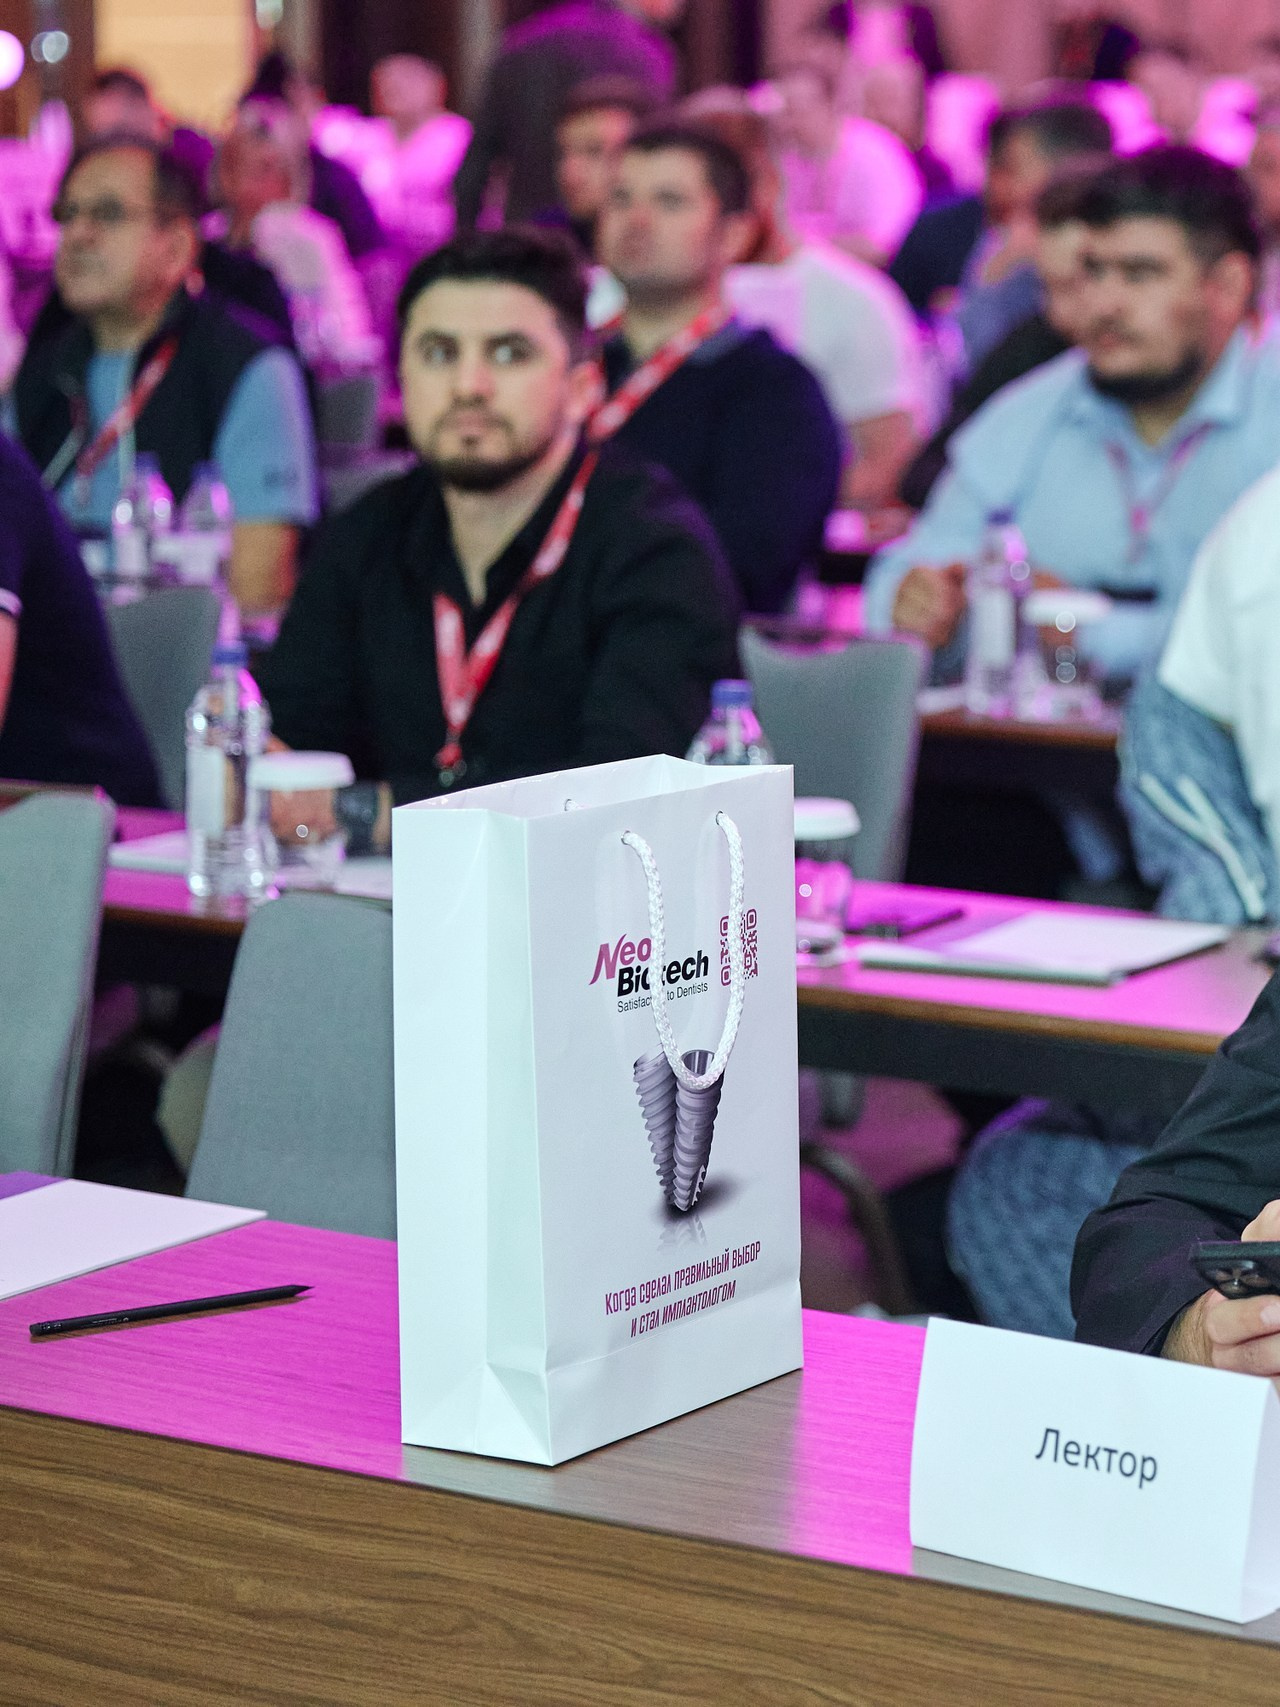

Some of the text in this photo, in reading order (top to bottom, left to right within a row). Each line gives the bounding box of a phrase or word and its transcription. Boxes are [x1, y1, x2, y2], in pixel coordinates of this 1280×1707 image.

[589, 933, 653, 985] Neo
[667, 990, 675, 1001] to
[677, 982, 708, 999] Dentists
[605, 1286, 637, 1315] Когда
[639, 1273, 672, 1304] сделал
[673, 1247, 731, 1291] правильный
[630, 1279, 737, 1338] и стал имплантологом
[1034, 1427, 1158, 1490] Лектор
